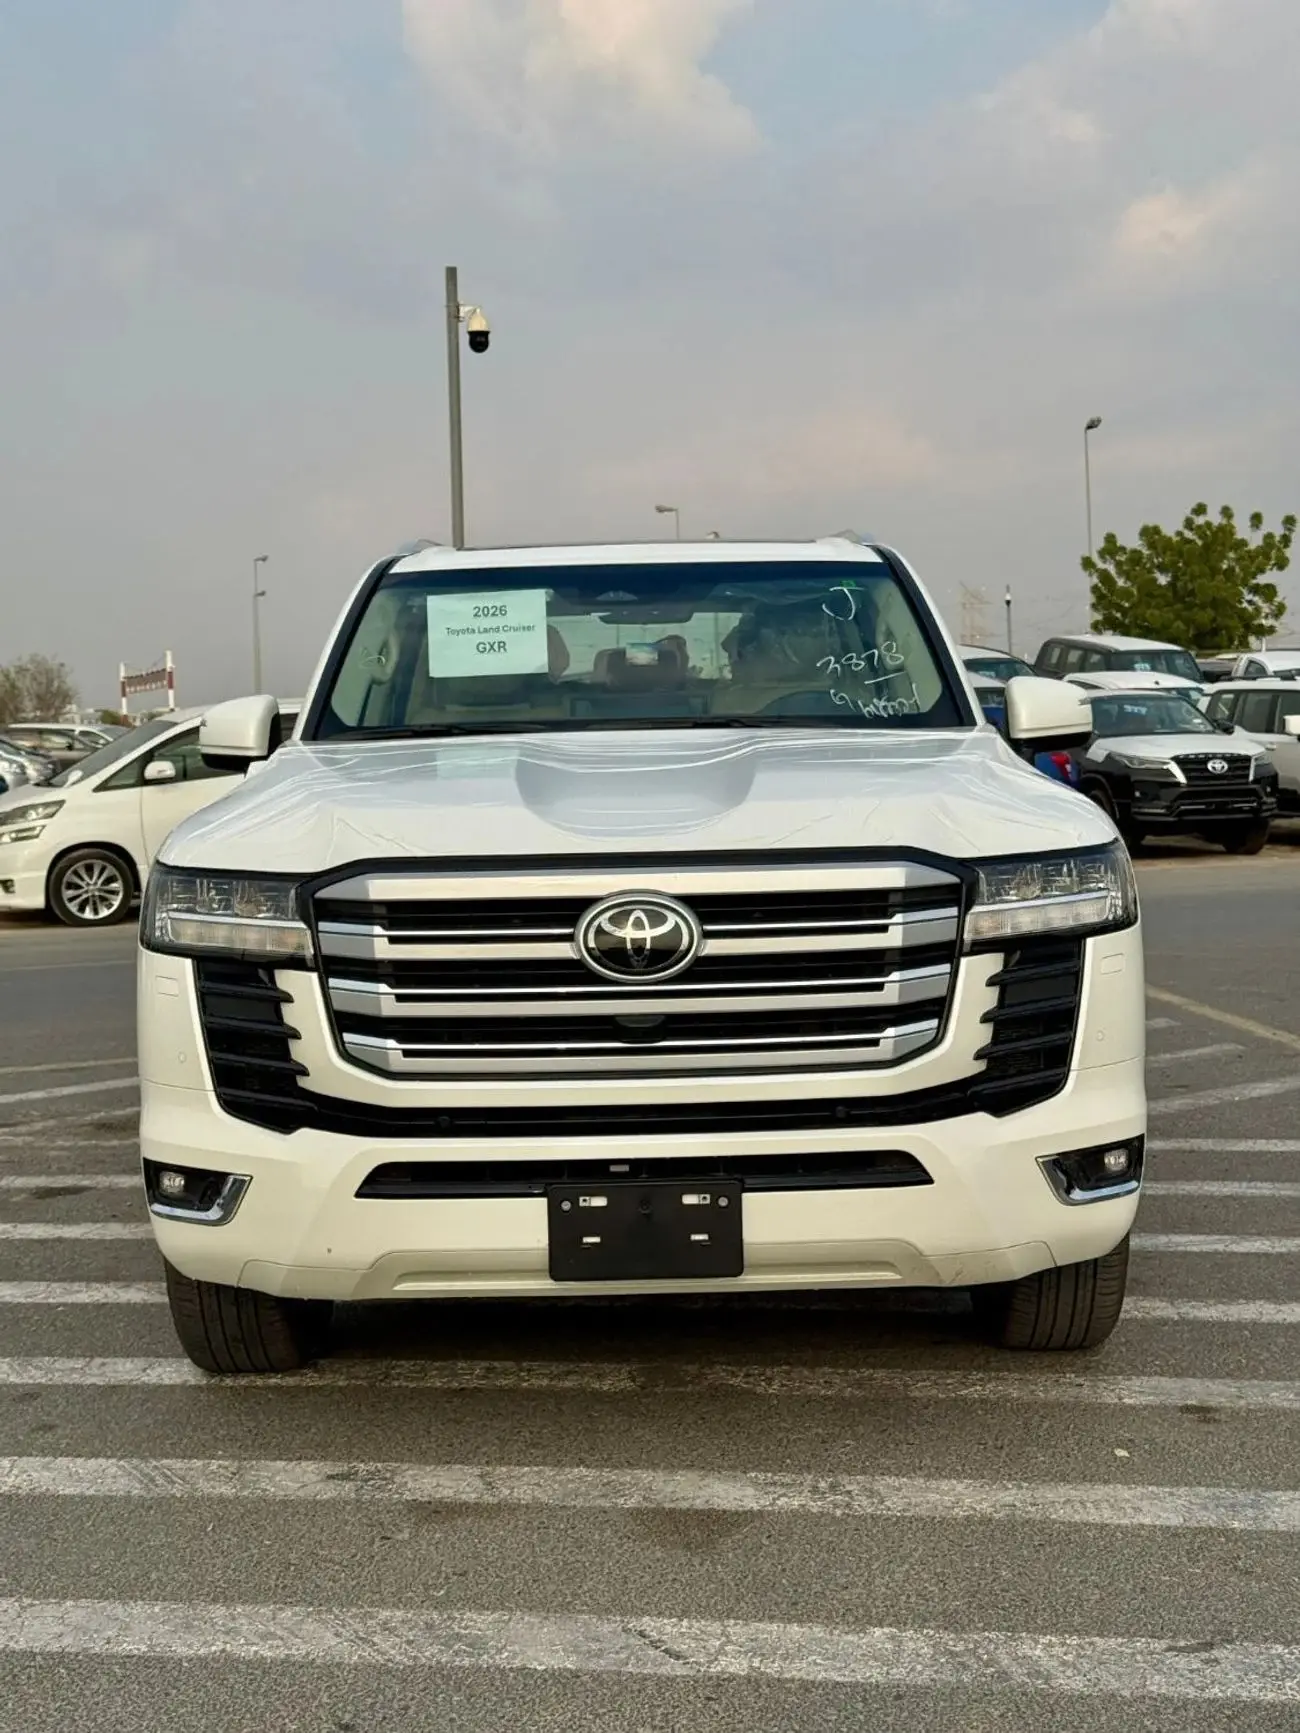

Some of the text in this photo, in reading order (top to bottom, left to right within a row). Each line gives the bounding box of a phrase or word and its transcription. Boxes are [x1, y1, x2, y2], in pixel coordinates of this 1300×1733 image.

[473, 605, 508, 618] 2026
[446, 624, 536, 636] Toyota Land Cruiser
[476, 641, 507, 653] GXR
